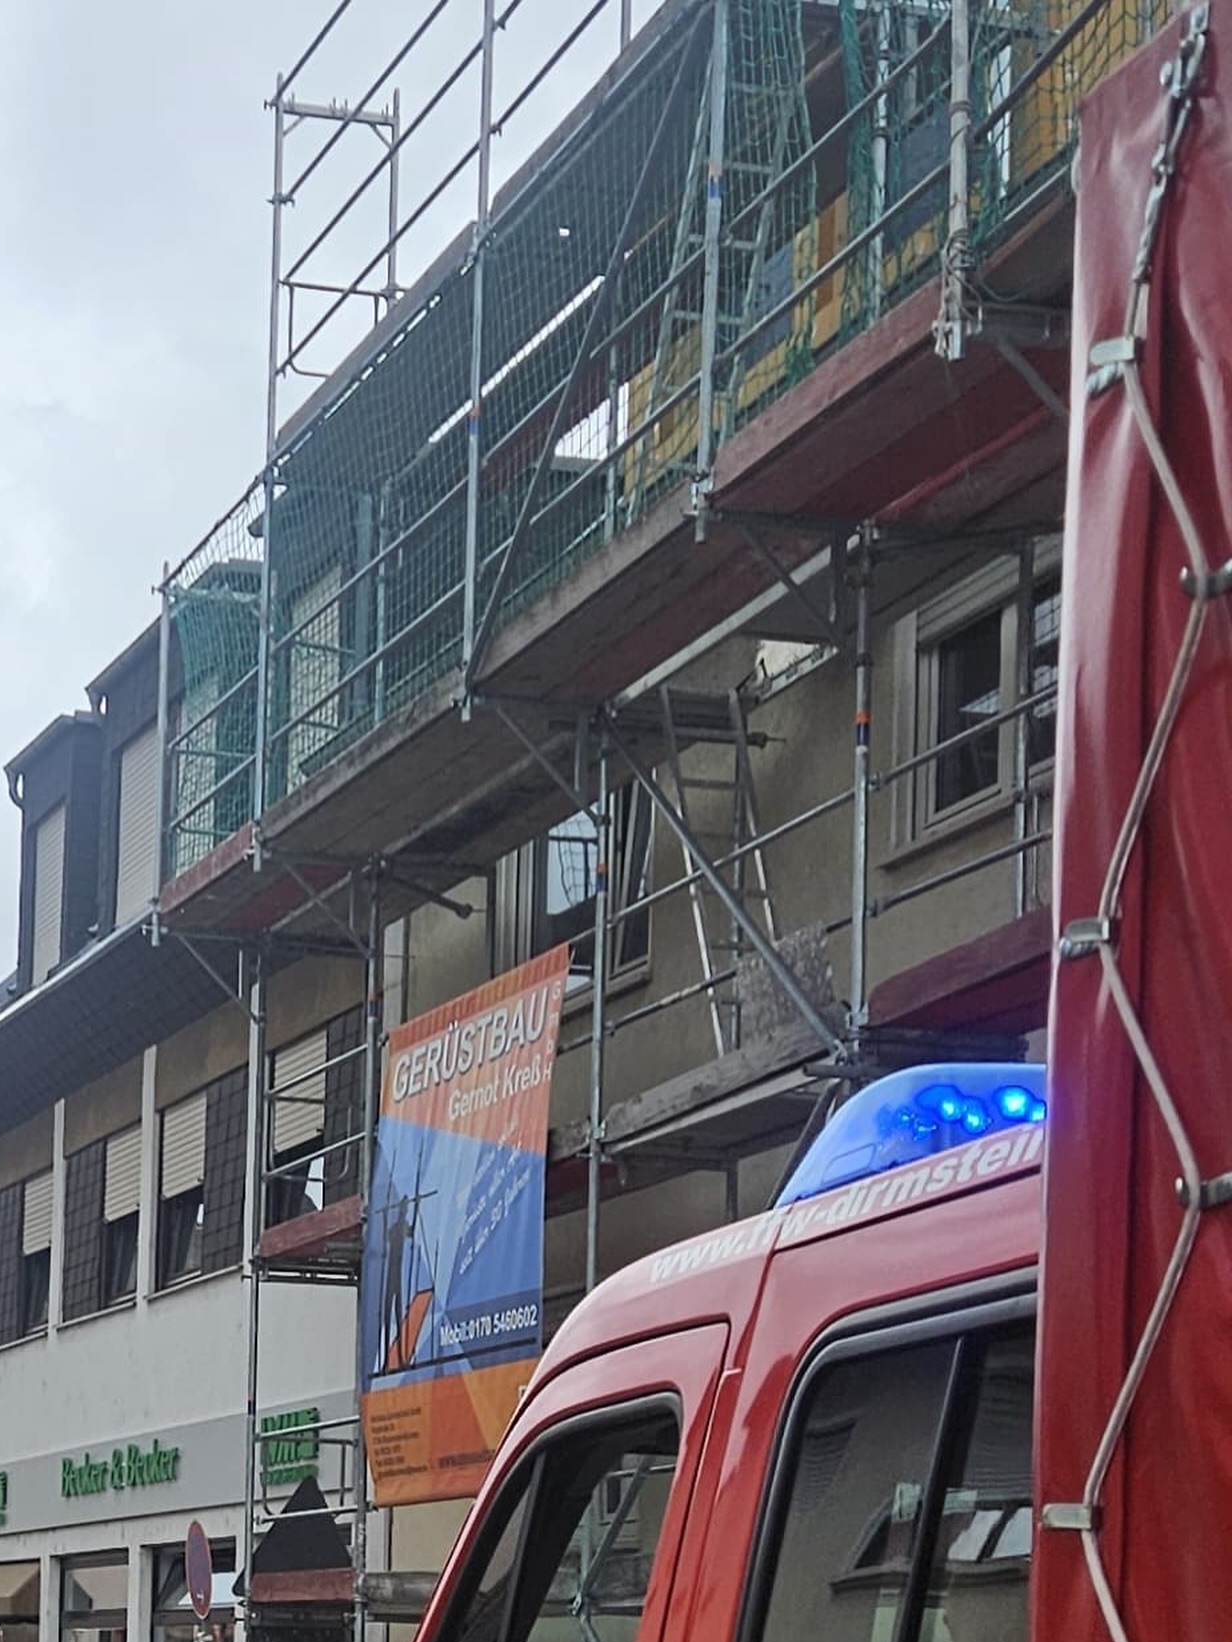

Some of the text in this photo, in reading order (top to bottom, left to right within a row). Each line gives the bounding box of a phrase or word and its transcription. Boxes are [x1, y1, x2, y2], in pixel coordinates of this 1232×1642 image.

[392, 985, 550, 1104] GERÜSTBAU
[448, 1054, 542, 1121] Gernot Kreß
